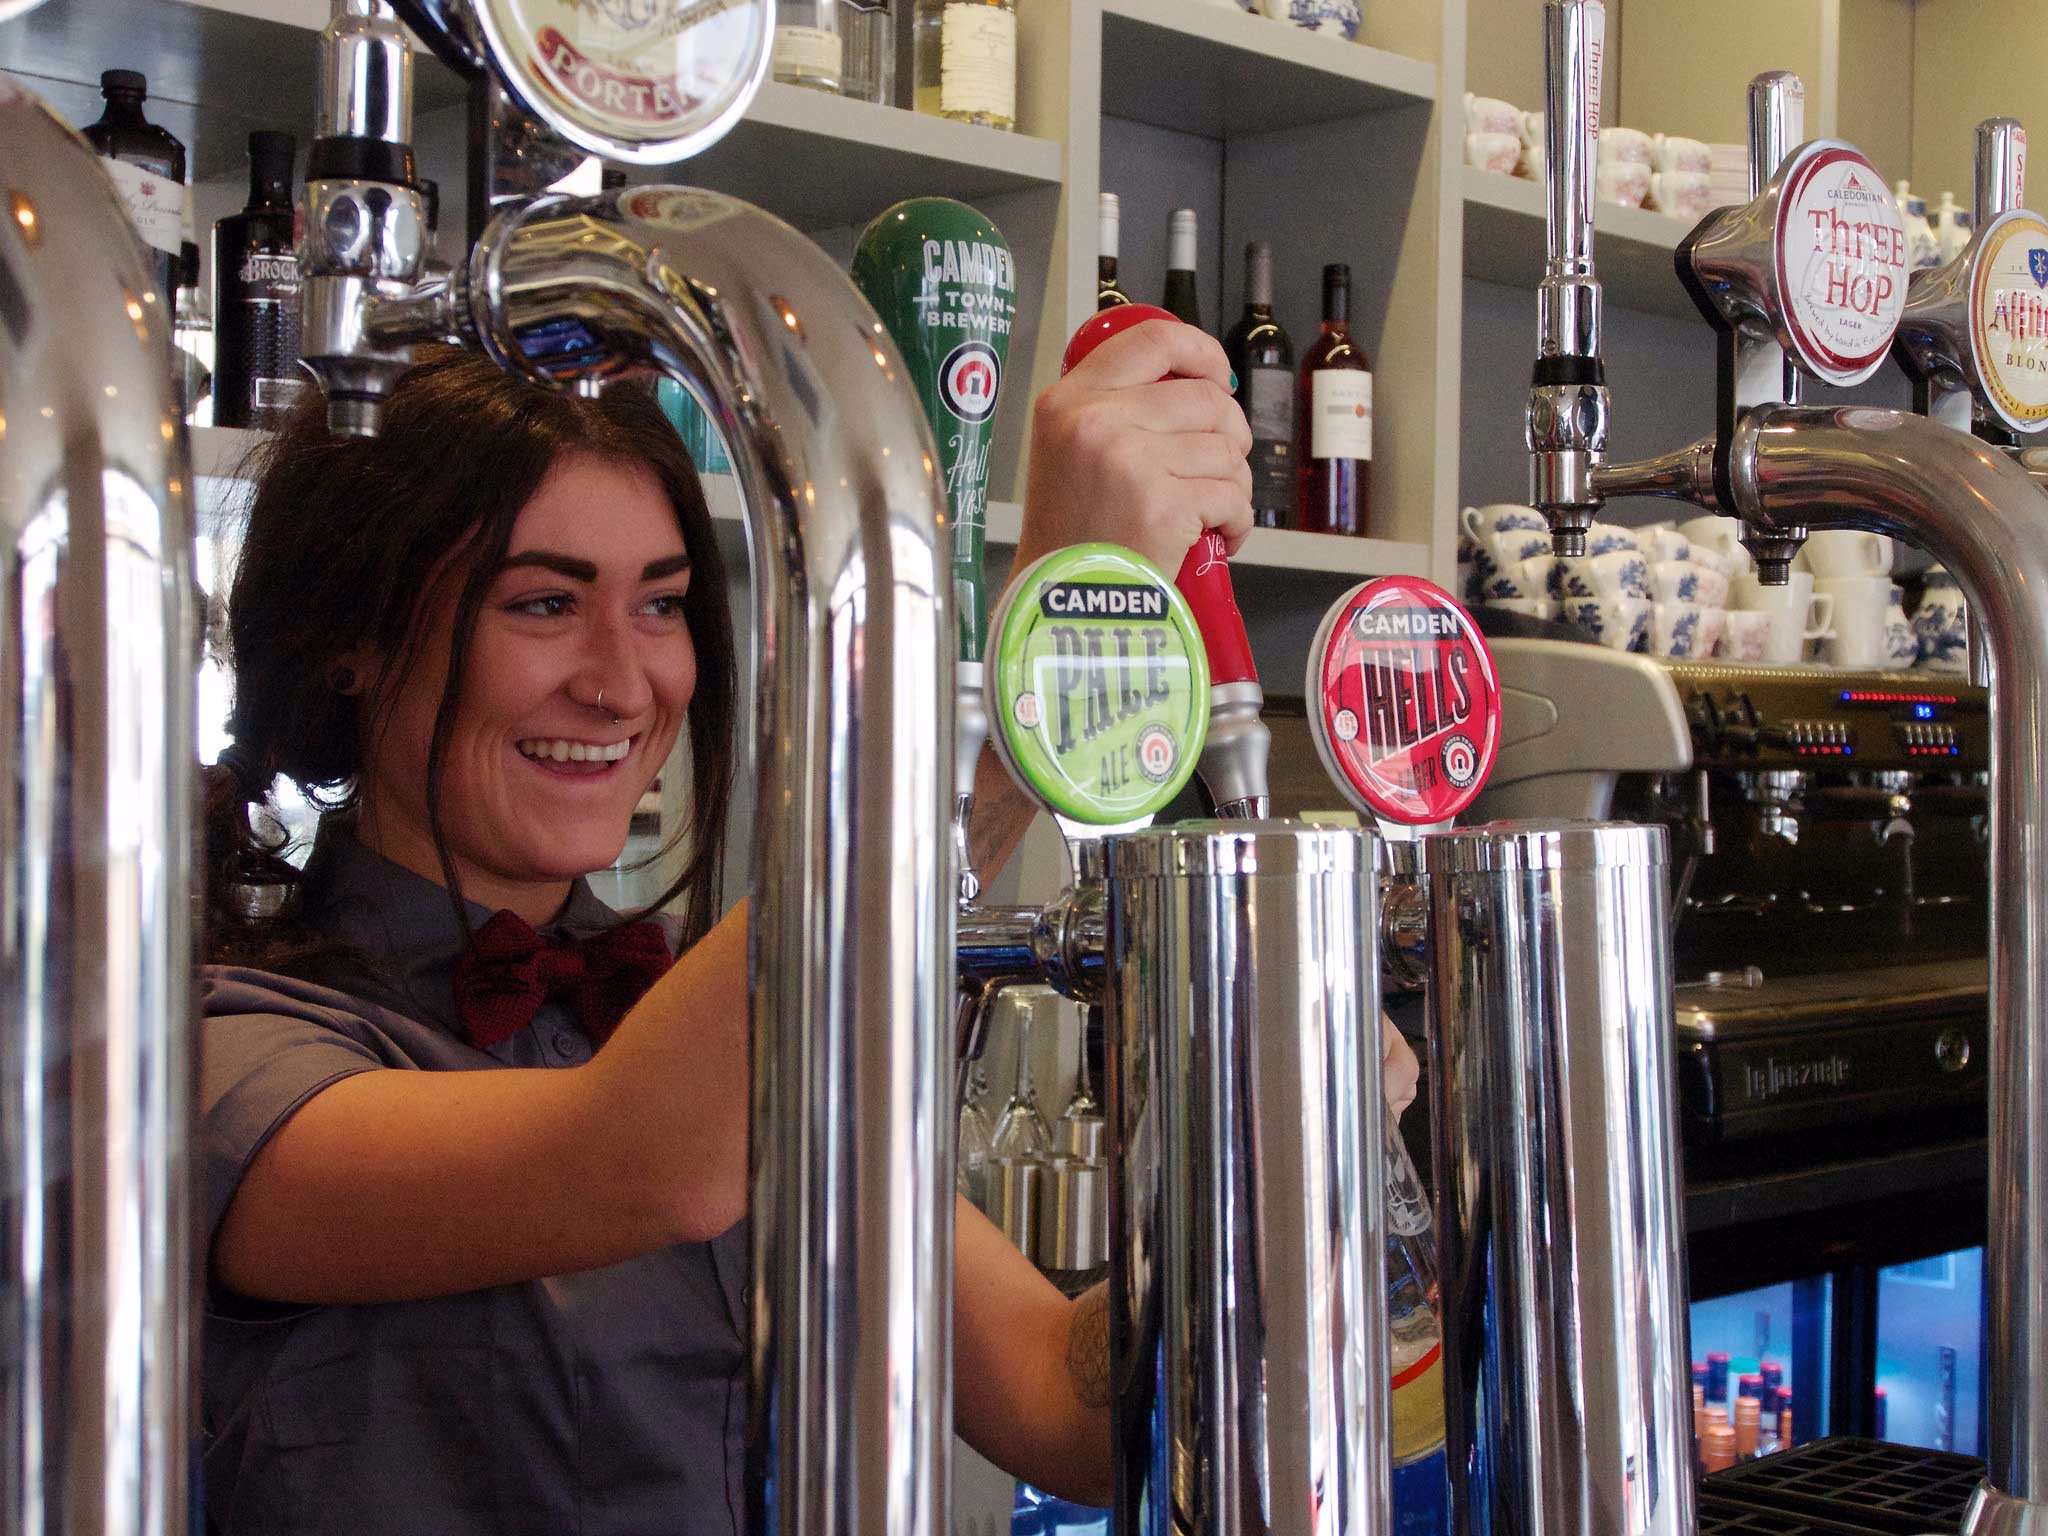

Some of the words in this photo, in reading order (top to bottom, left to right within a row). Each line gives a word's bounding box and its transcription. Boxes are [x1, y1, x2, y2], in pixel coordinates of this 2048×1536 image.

[1587, 102, 1600, 140] HOP
[1827, 189, 1883, 204] CALEDONIAN
[922, 239, 1015, 293] CAMDEN
[944, 291, 1005, 313] TOWN
[1824, 260, 1893, 317] HOP
[926, 311, 1012, 335] BREWERY
[1839, 318, 1862, 330] LAGER
[1048, 588, 1163, 615] CAMDEN
[1358, 613, 1459, 635] CAMDEN
[1050, 625, 1170, 757] PALE
[1360, 645, 1472, 768] HELLS
[1100, 743, 1130, 798] ALE
